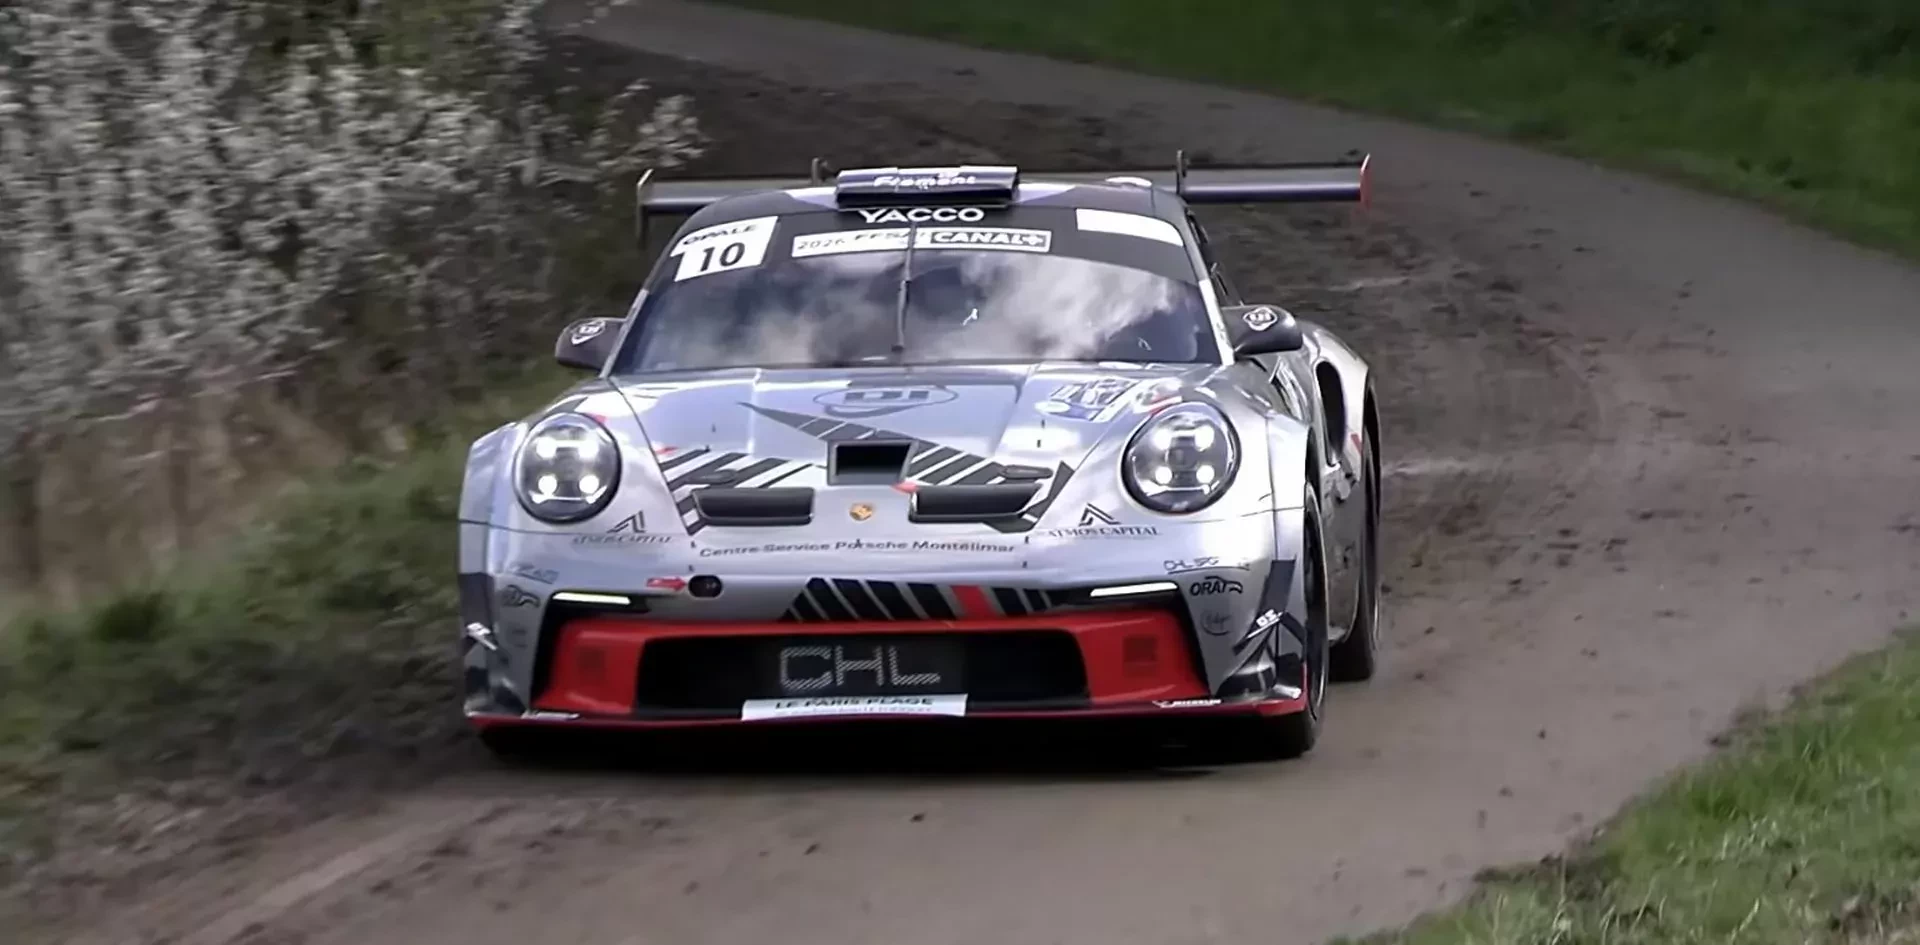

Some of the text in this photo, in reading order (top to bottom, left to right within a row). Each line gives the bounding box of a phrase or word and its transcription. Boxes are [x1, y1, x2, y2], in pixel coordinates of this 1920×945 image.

[858, 208, 985, 223] YACCO
[683, 224, 758, 245] OPALE
[932, 231, 1046, 246] CANAL+
[700, 242, 745, 272] 10
[700, 546, 760, 558] Centre
[763, 542, 831, 552] Service
[835, 540, 908, 550] Porsche
[780, 646, 941, 691] CHL
